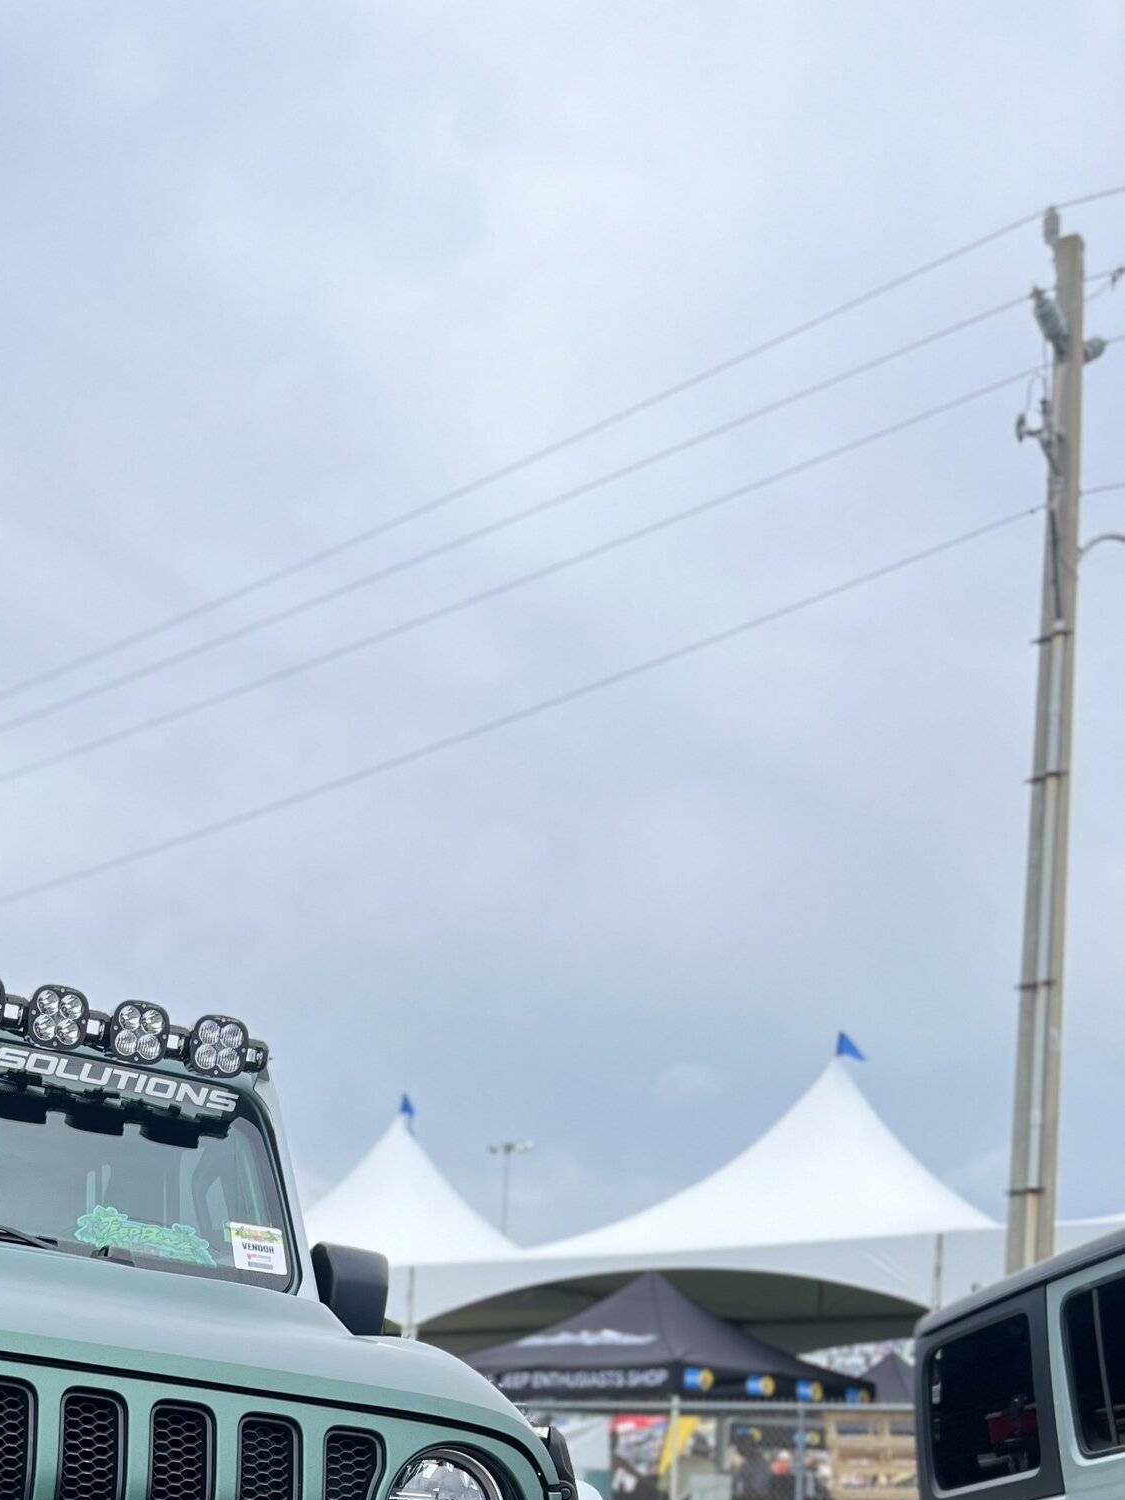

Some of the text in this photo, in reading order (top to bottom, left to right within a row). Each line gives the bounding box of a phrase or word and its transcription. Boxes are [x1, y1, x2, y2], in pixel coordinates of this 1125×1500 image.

[241, 1242, 275, 1254] VENDOR
[531, 1370, 623, 1389] ENTHUSIASTS
[624, 1368, 670, 1387] SHOP
